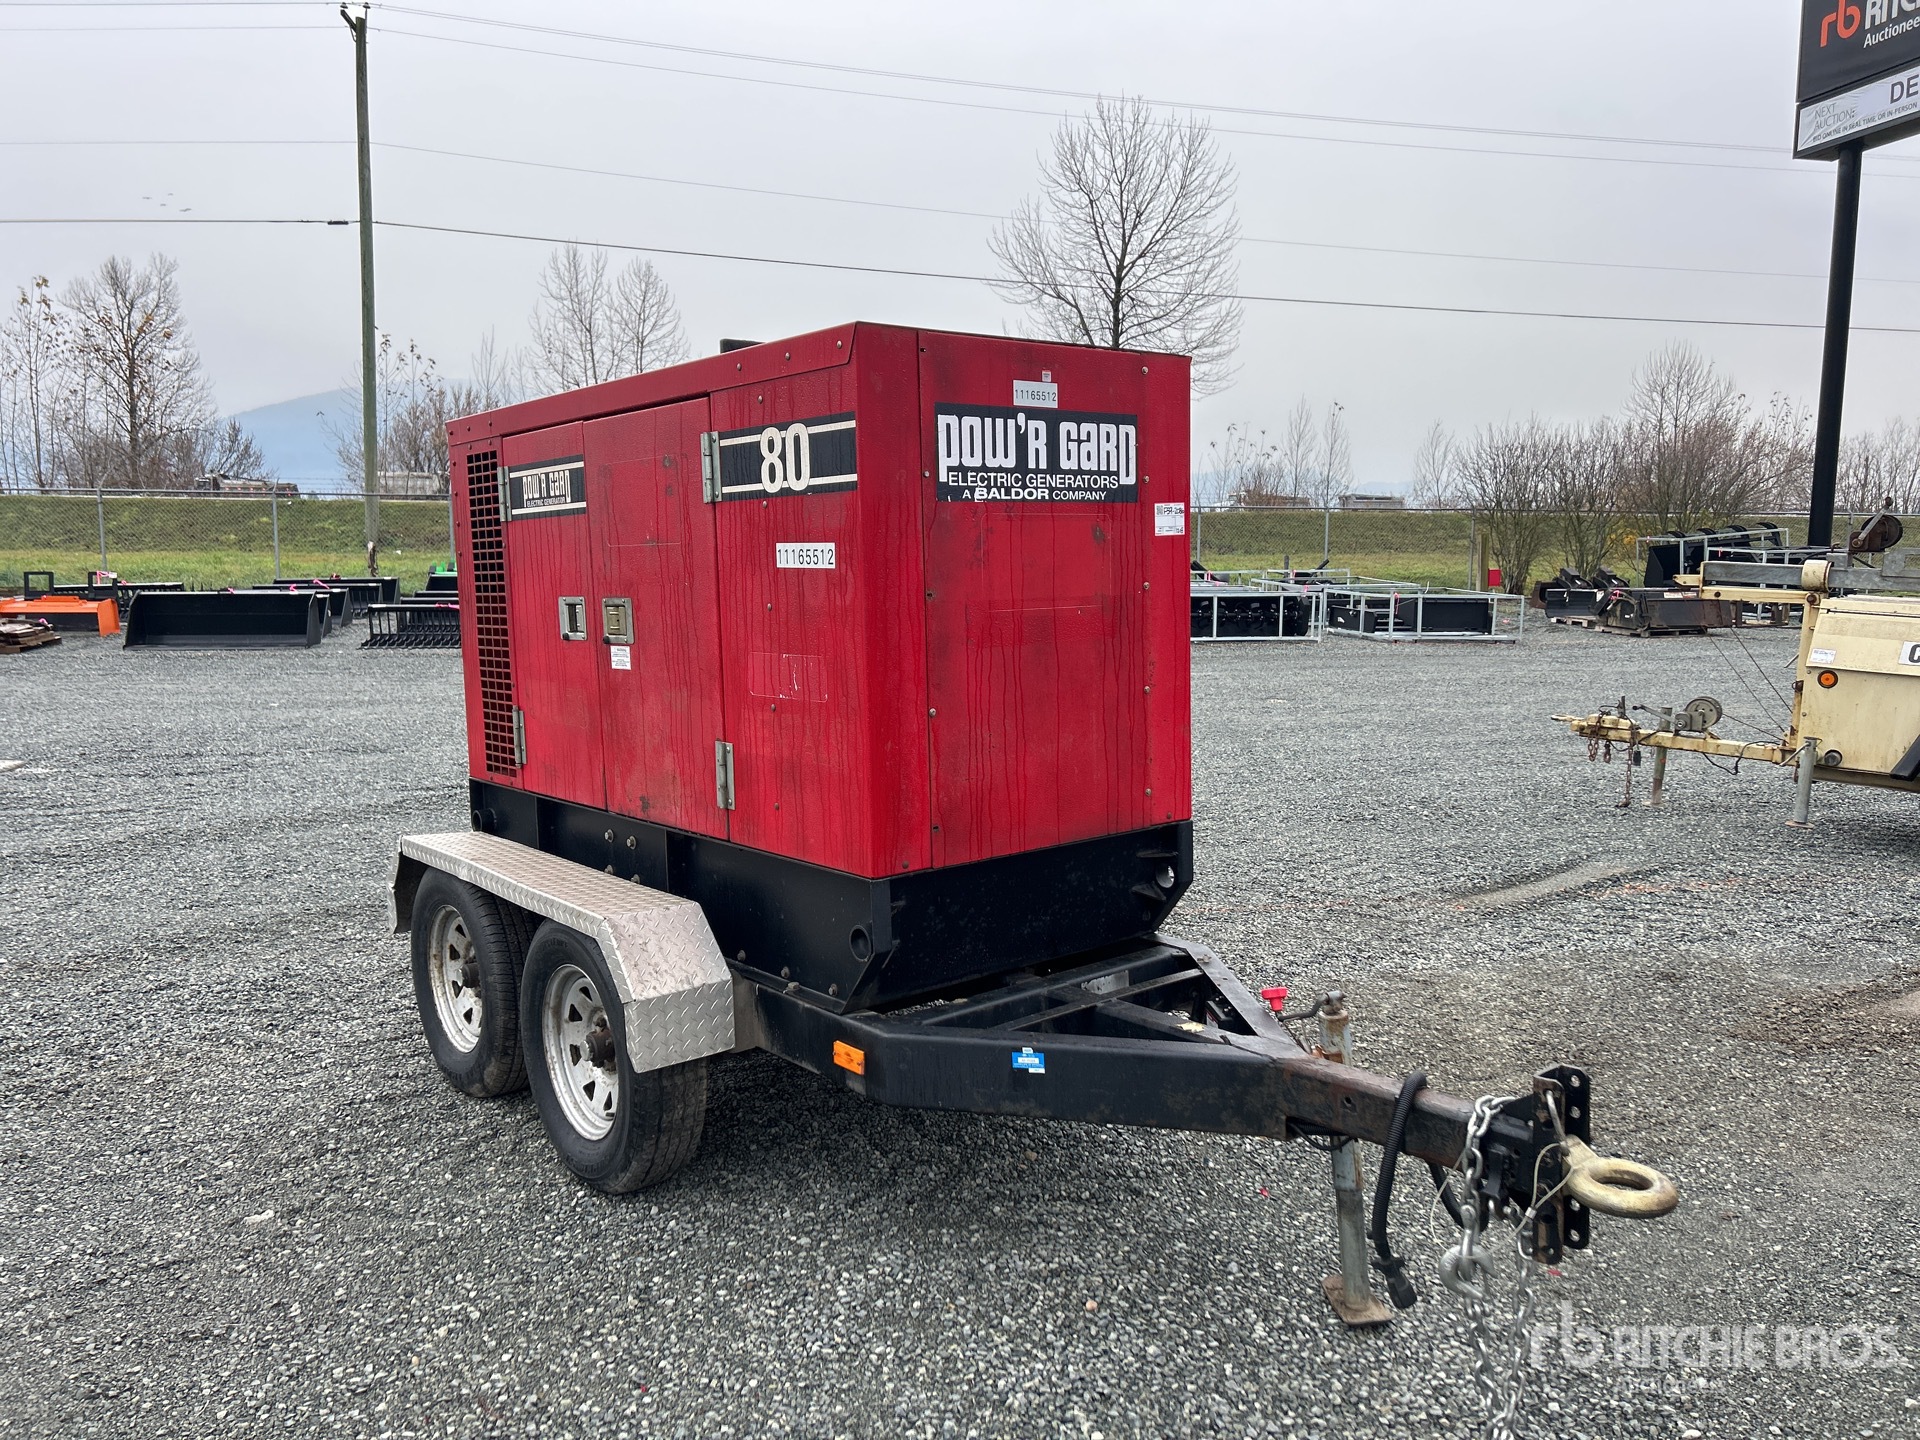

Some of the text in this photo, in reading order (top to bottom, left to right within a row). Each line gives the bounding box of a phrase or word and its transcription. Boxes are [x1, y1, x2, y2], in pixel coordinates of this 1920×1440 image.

[1889, 74, 1919, 104] DE
[1814, 103, 1837, 119] NEXT
[1015, 389, 1057, 402] 11165512
[760, 423, 810, 493] 80
[949, 472, 1118, 489] ELECTRIC GENERATORS
[962, 488, 1107, 501] A BALDOR COMPANY
[777, 548, 834, 565] 11165512
